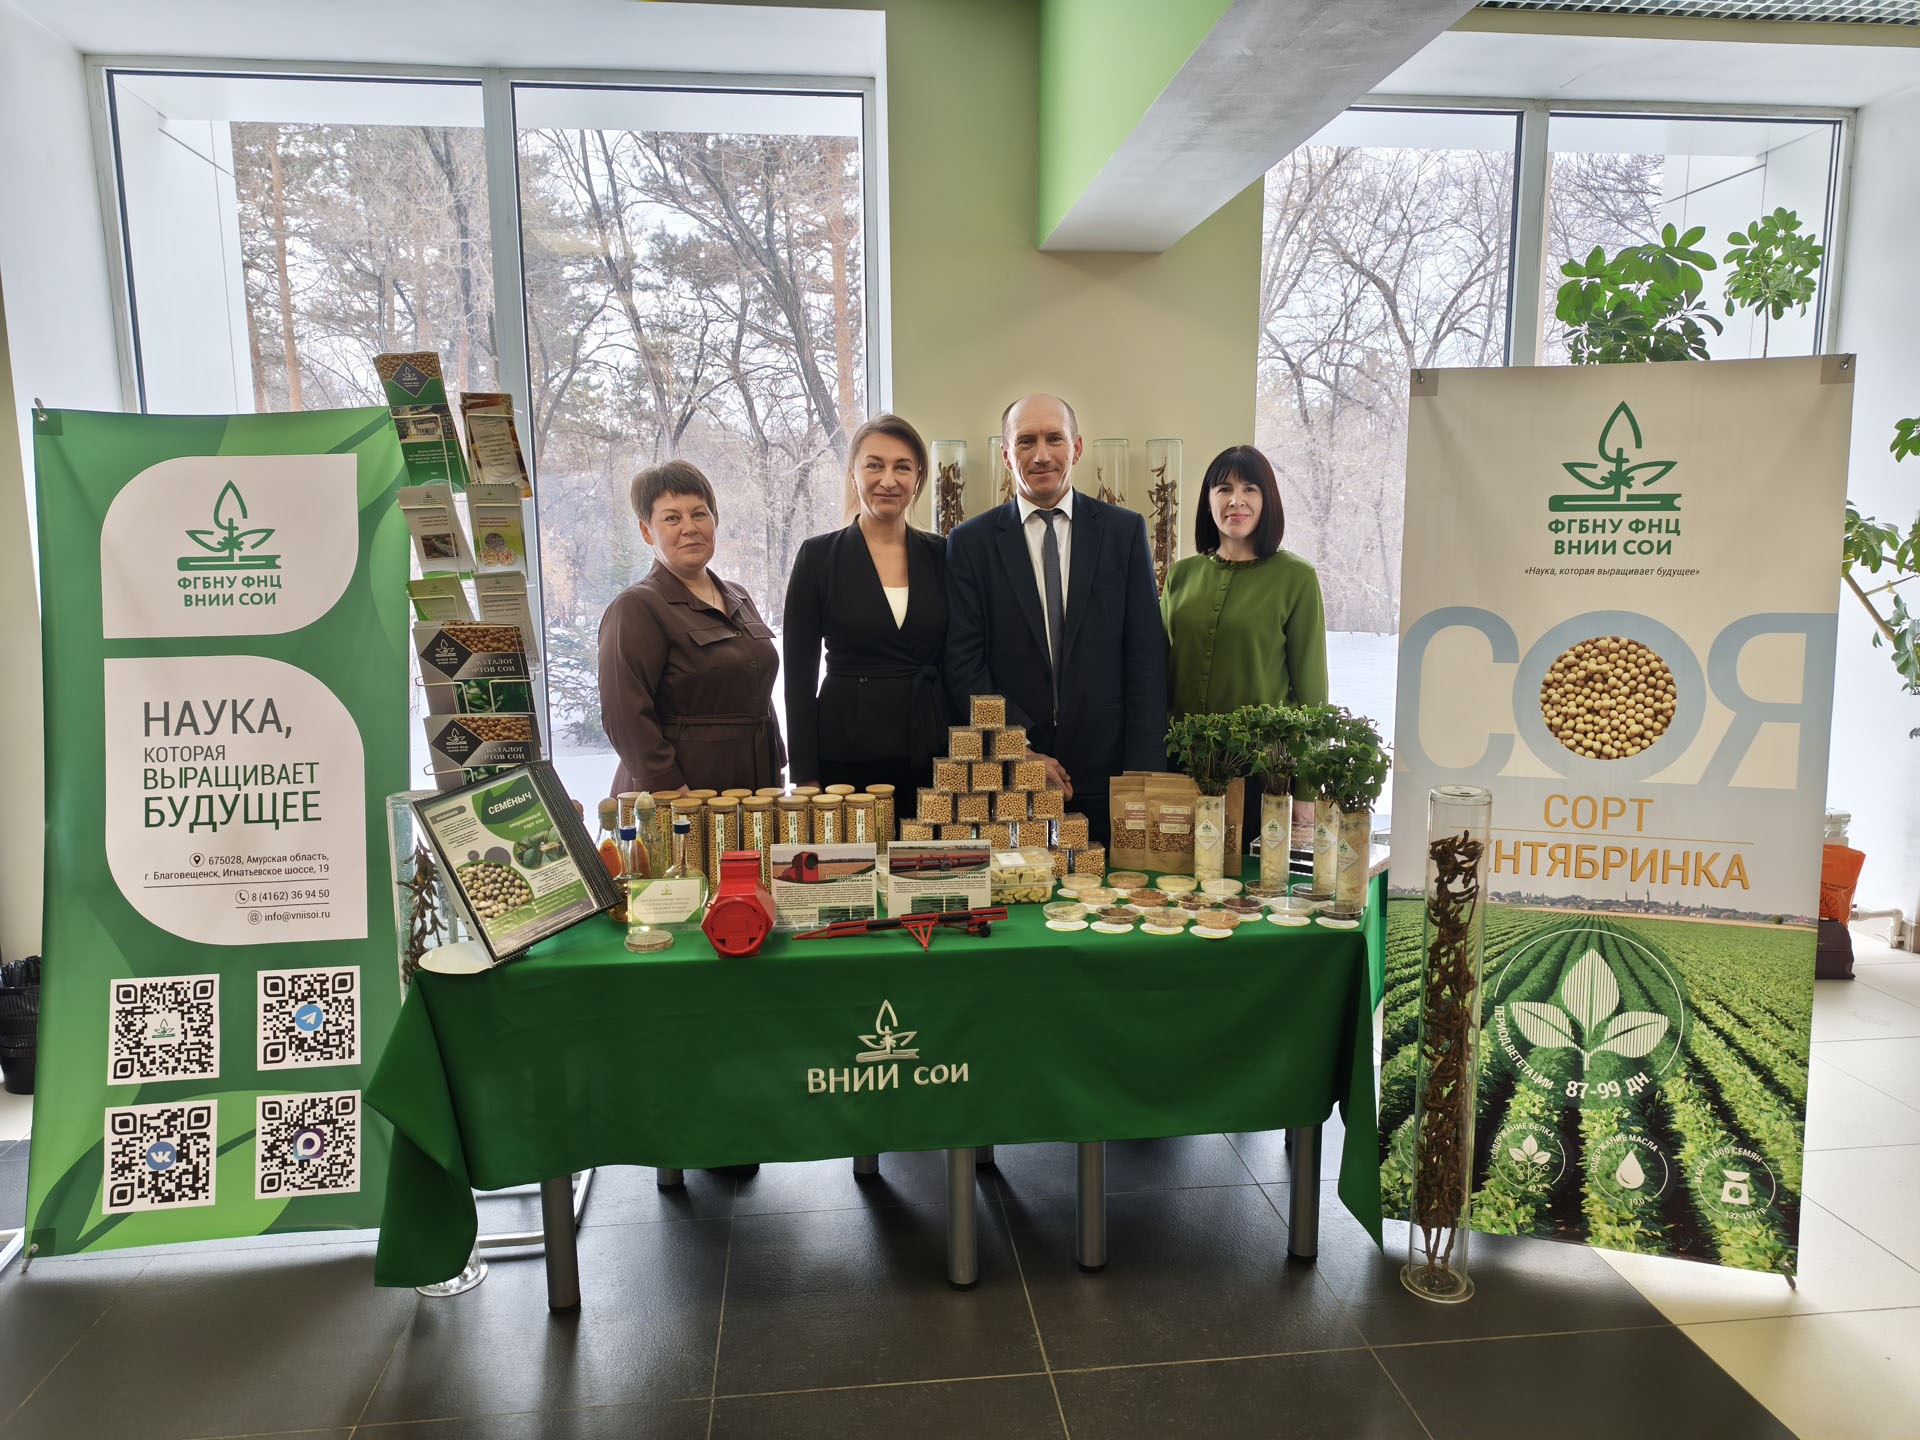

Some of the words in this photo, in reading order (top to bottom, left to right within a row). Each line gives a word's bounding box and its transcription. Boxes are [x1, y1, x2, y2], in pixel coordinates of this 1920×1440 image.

[1548, 518, 1623, 535] ФГБНУ
[1628, 518, 1681, 537] ФНЦ
[1553, 539, 1617, 555] ВНИИ
[1623, 539, 1672, 555] СОИ
[177, 576, 237, 590] ФГБНУ
[241, 575, 282, 589] ФНЦ
[1524, 567, 1557, 576] «Наука,
[1559, 568, 1595, 576] которая
[1597, 568, 1655, 576] выращивает
[1656, 567, 1700, 577] будущее»
[183, 593, 234, 607] ВНИИ
[238, 592, 276, 605] СОИ
[1397, 605, 1838, 789] СОЯ
[143, 698, 292, 738] НАУКА,
[144, 744, 226, 763] КОТОРАЯ
[143, 762, 319, 791] ВЫРАЩИВАЕТ
[144, 790, 322, 833] БУДУЩЕЕ
[488, 791, 532, 815] СЕМЁНЫЧ
[1543, 793, 1654, 831] СОРТ
[153, 870, 221, 880] Благовещенск,
[222, 868, 282, 878] Игнатьевское
[284, 866, 316, 875] шоссе,
[318, 864, 329, 873] 19
[208, 855, 244, 866] 675028,
[246, 854, 287, 865] Амурская
[290, 853, 329, 862] область,
[1457, 837, 1750, 890] НТЯБРИНКА
[251, 892, 257, 901] 8
[259, 890, 289, 903] (4162)
[291, 890, 303, 899] 36
[305, 889, 317, 899] 94
[318, 889, 330, 898] 50
[264, 910, 331, 922] info@vniisoi.ru
[1494, 1005, 1511, 1047] ПЕРИОД
[807, 1063, 899, 1093] ВНИИ
[1502, 1045, 1554, 1090] ВЕГЕТАЦИИ
[1565, 1080, 1622, 1099] 87-99
[1625, 1071, 1653, 1097] ДН.
[1491, 1122, 1528, 1160] СОДЕРЖАНИЕ
[1529, 1122, 1555, 1139] БЕЛКА
[1590, 1134, 1628, 1173] СОДЕРЖАНИЕ
[1628, 1134, 1658, 1152] МАСЛА
[1694, 1157, 1711, 1184] МАССА
[1709, 1147, 1730, 1159] 1000
[1732, 1147, 1763, 1163] СЕМЯН
